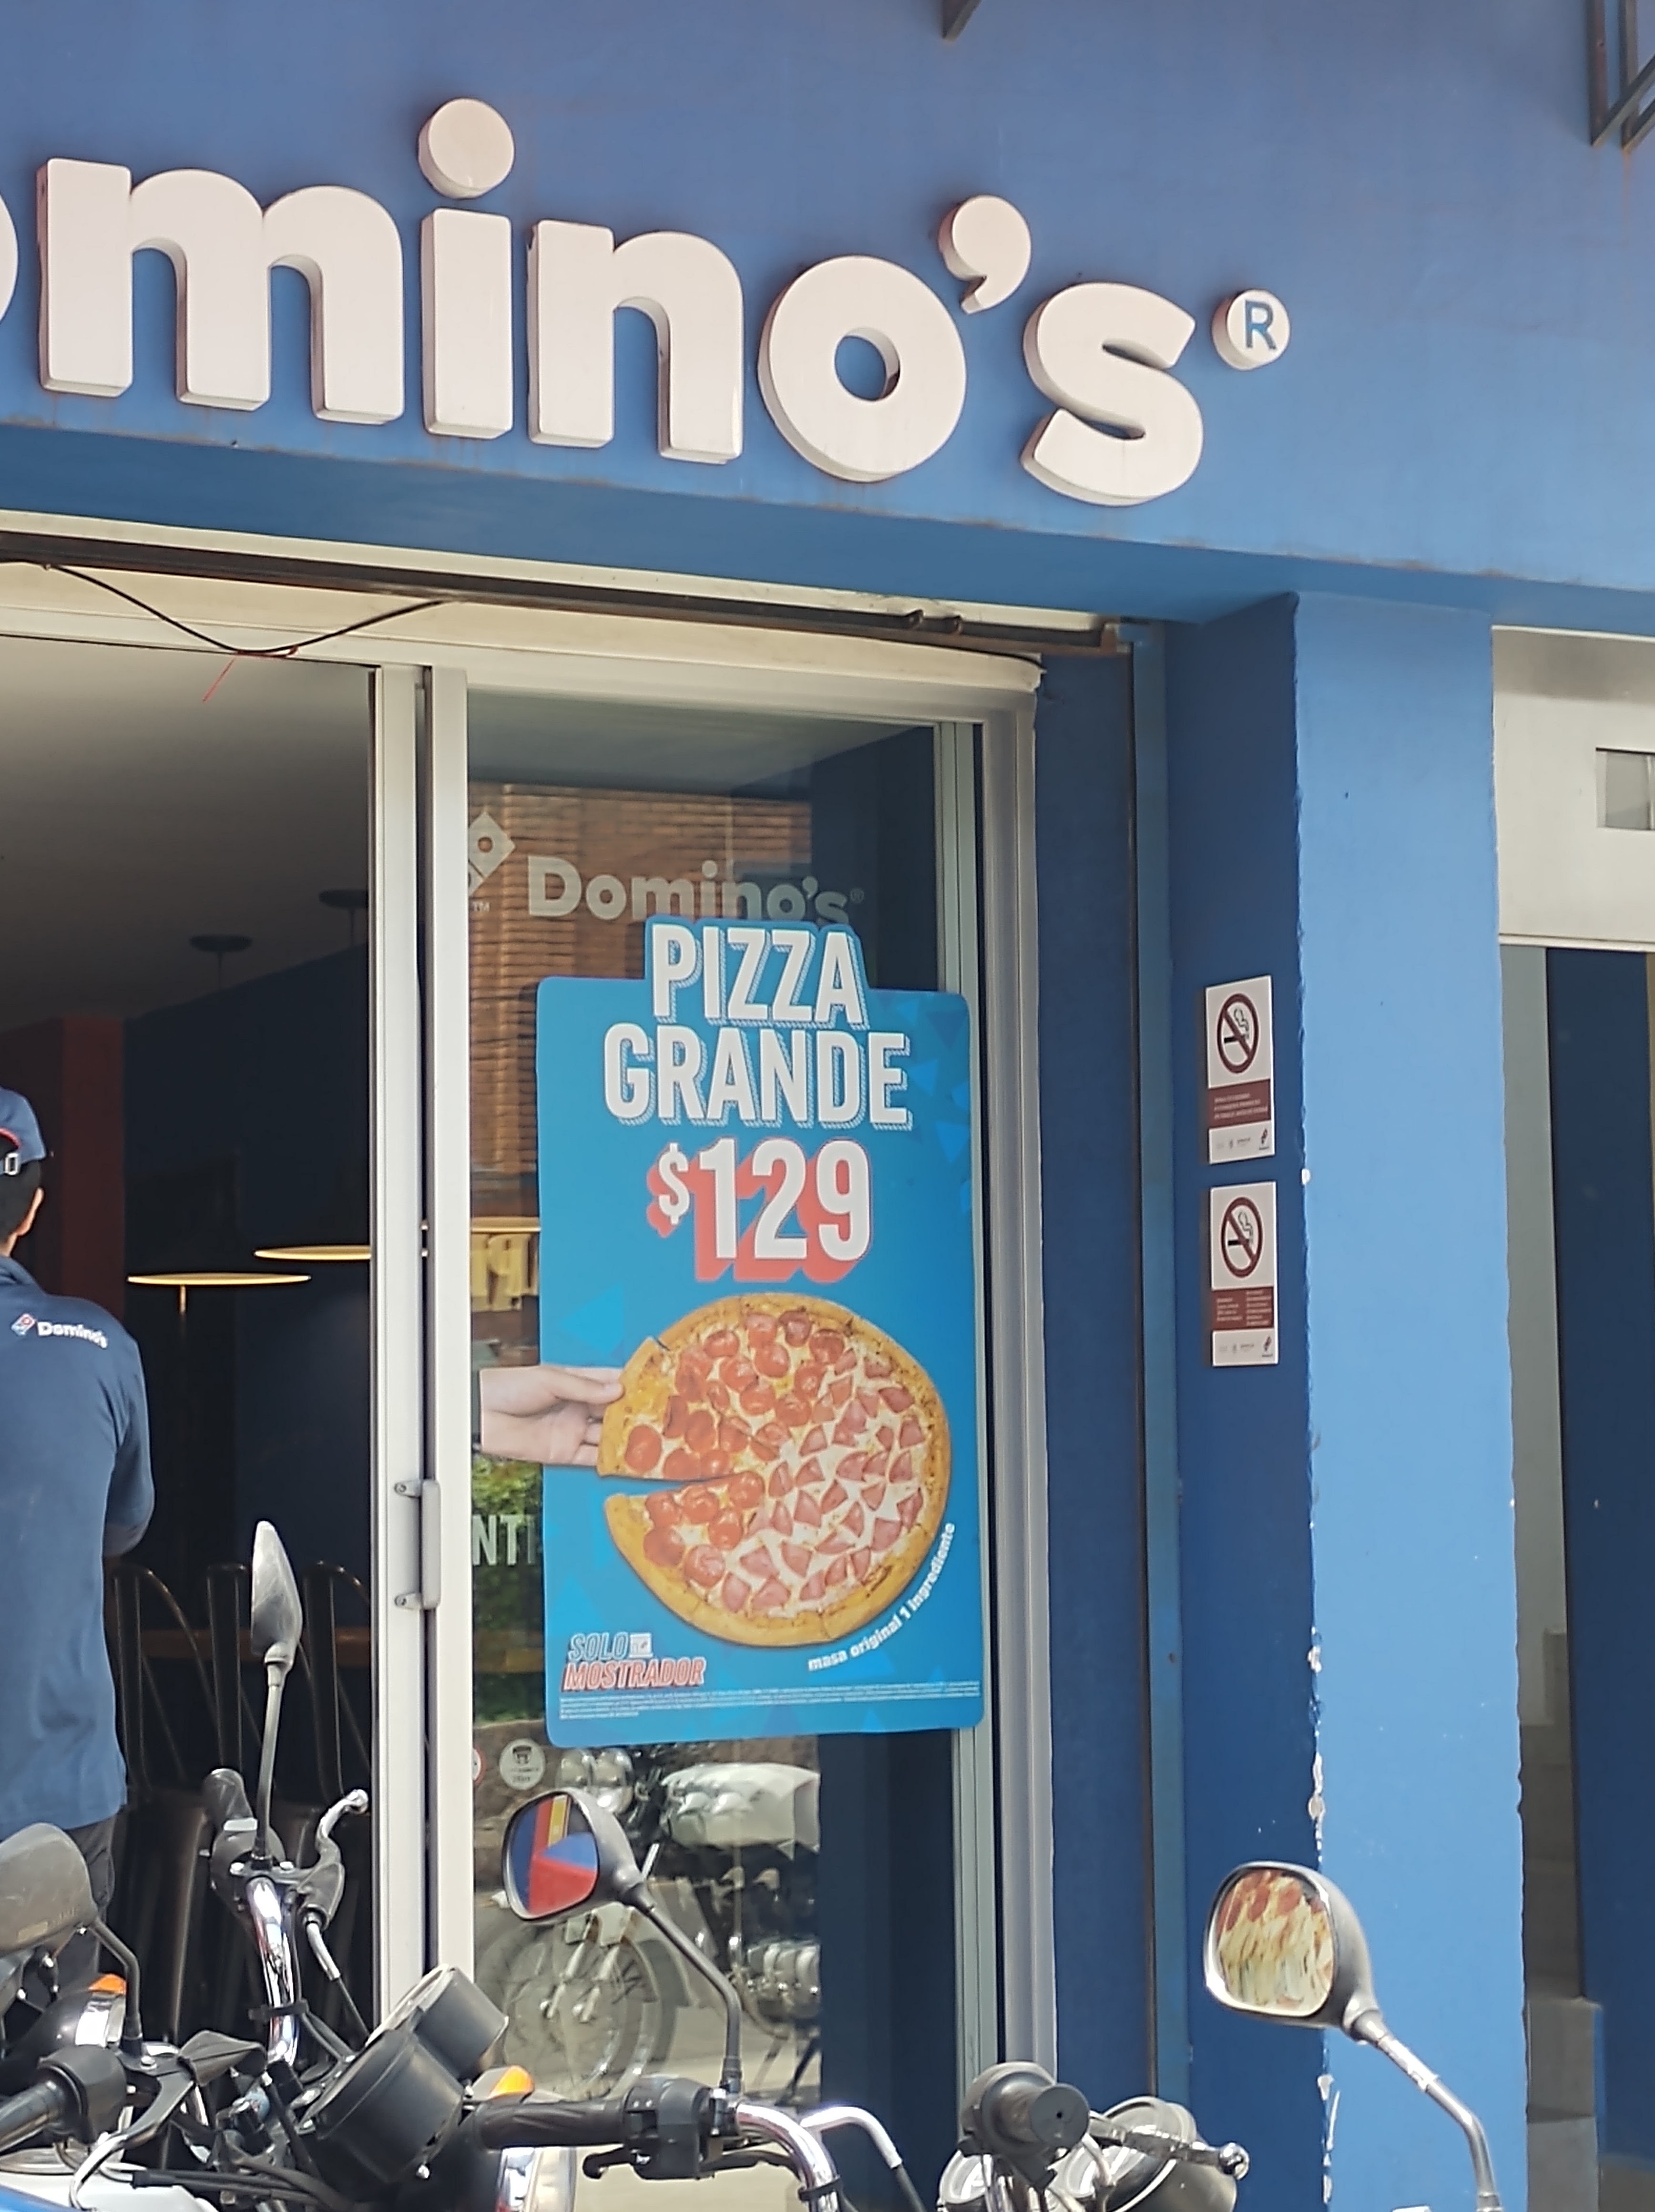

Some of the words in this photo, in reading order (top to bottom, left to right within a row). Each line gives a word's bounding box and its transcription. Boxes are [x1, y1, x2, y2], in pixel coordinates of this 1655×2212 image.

[0, 98, 1204, 507] mino's
[527, 855, 850, 924] Domino's
[652, 923, 869, 1030] PIZZA
[603, 1023, 912, 1130] GRANDE
[654, 1138, 871, 1266] $129
[562, 1657, 707, 1692] MOSTRADOR
[567, 1631, 629, 1661] SOLO
[807, 1649, 848, 1671] masa
[849, 1614, 903, 1658] original
[899, 1605, 912, 1619] 1
